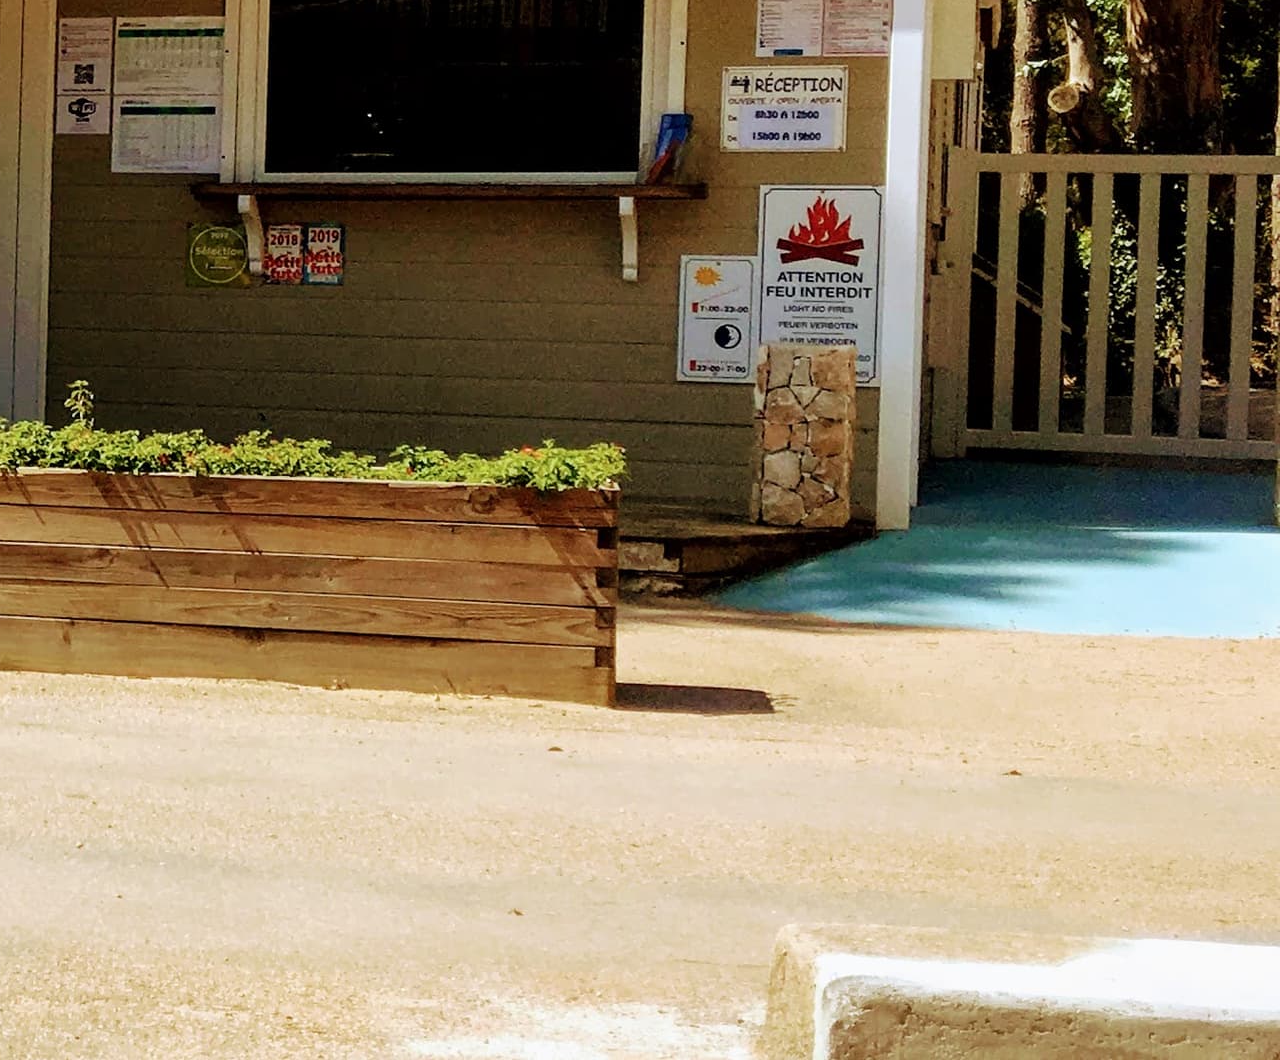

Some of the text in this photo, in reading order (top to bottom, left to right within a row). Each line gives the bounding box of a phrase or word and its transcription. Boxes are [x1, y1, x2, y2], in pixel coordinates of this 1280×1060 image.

[755, 72, 843, 92] RÉCEPTION
[270, 233, 299, 246] 2018
[310, 229, 340, 243] 2019
[777, 271, 864, 283] ATTENTION
[766, 286, 873, 299] FEU INTERDIT
[811, 305, 825, 313] NO
[778, 321, 858, 329] FEUER VERBOTEN
